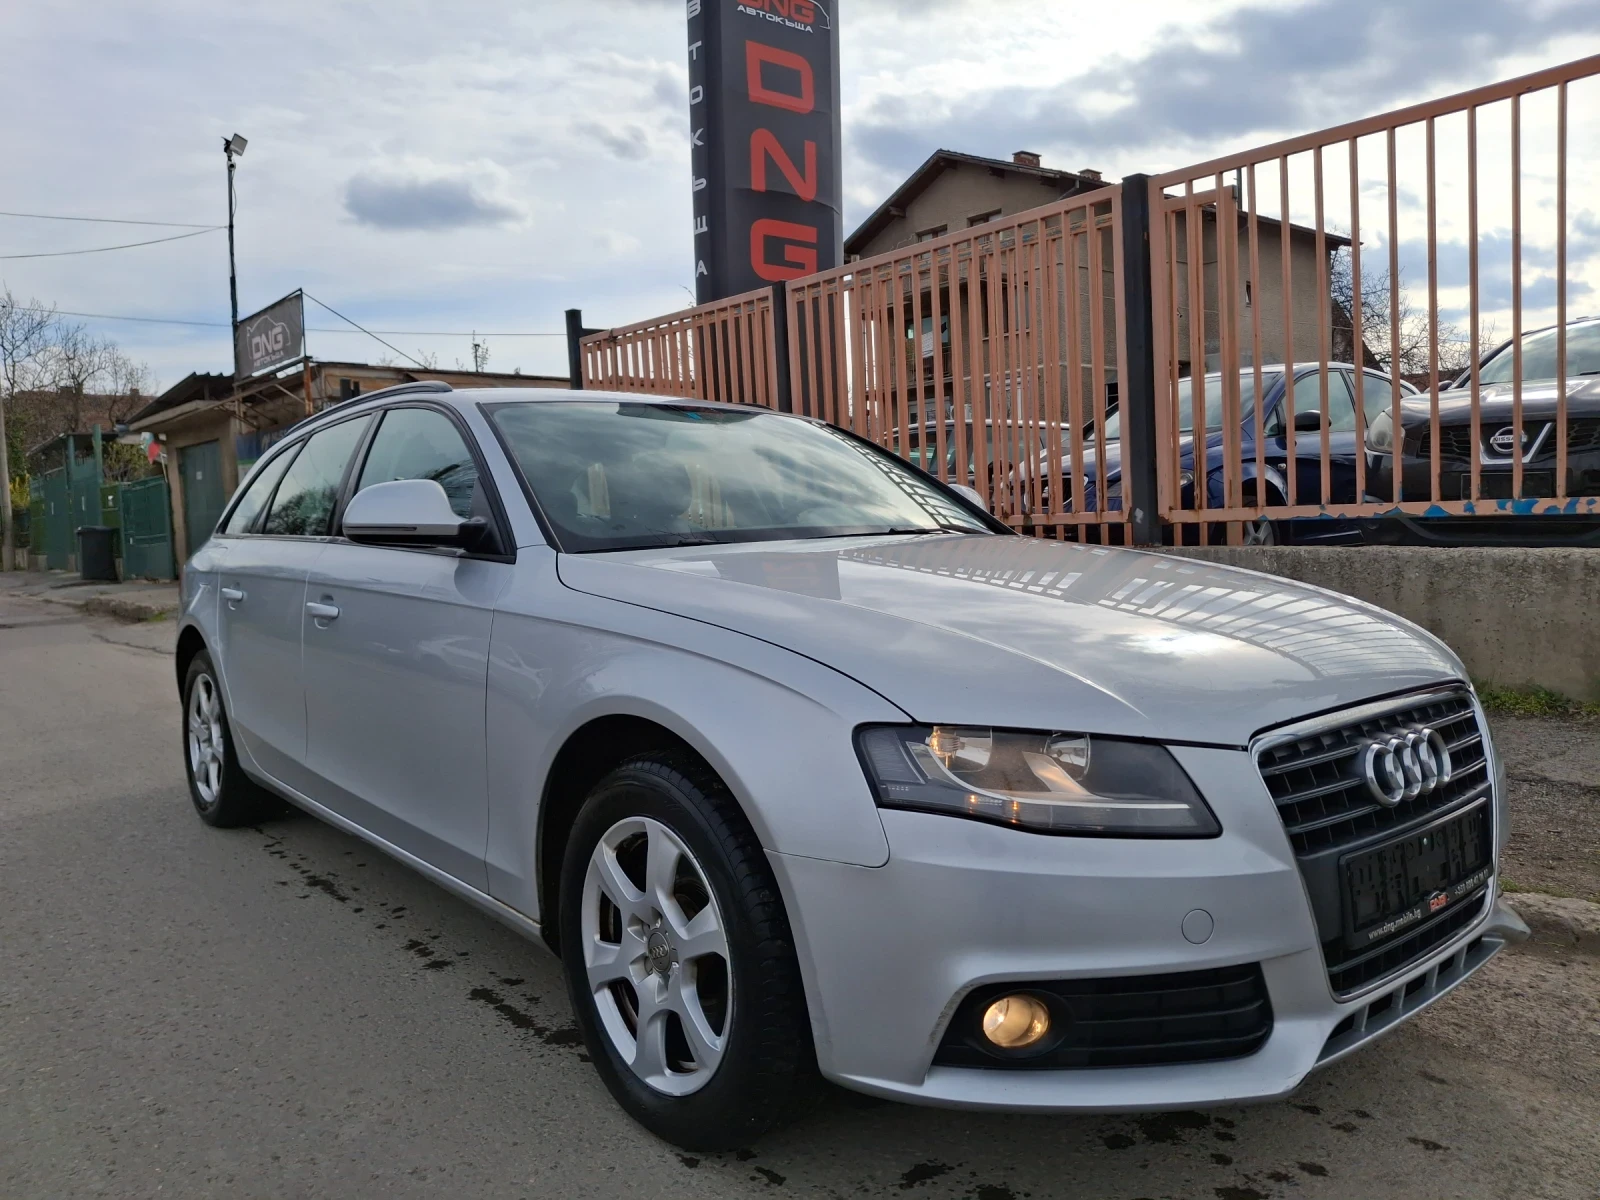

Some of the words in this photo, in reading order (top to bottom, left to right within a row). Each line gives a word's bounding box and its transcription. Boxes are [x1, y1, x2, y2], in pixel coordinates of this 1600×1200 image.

[737, 4, 814, 33] АВТОКЪЩА
[745, 39, 817, 282] DNG
[252, 325, 283, 360] DNG
